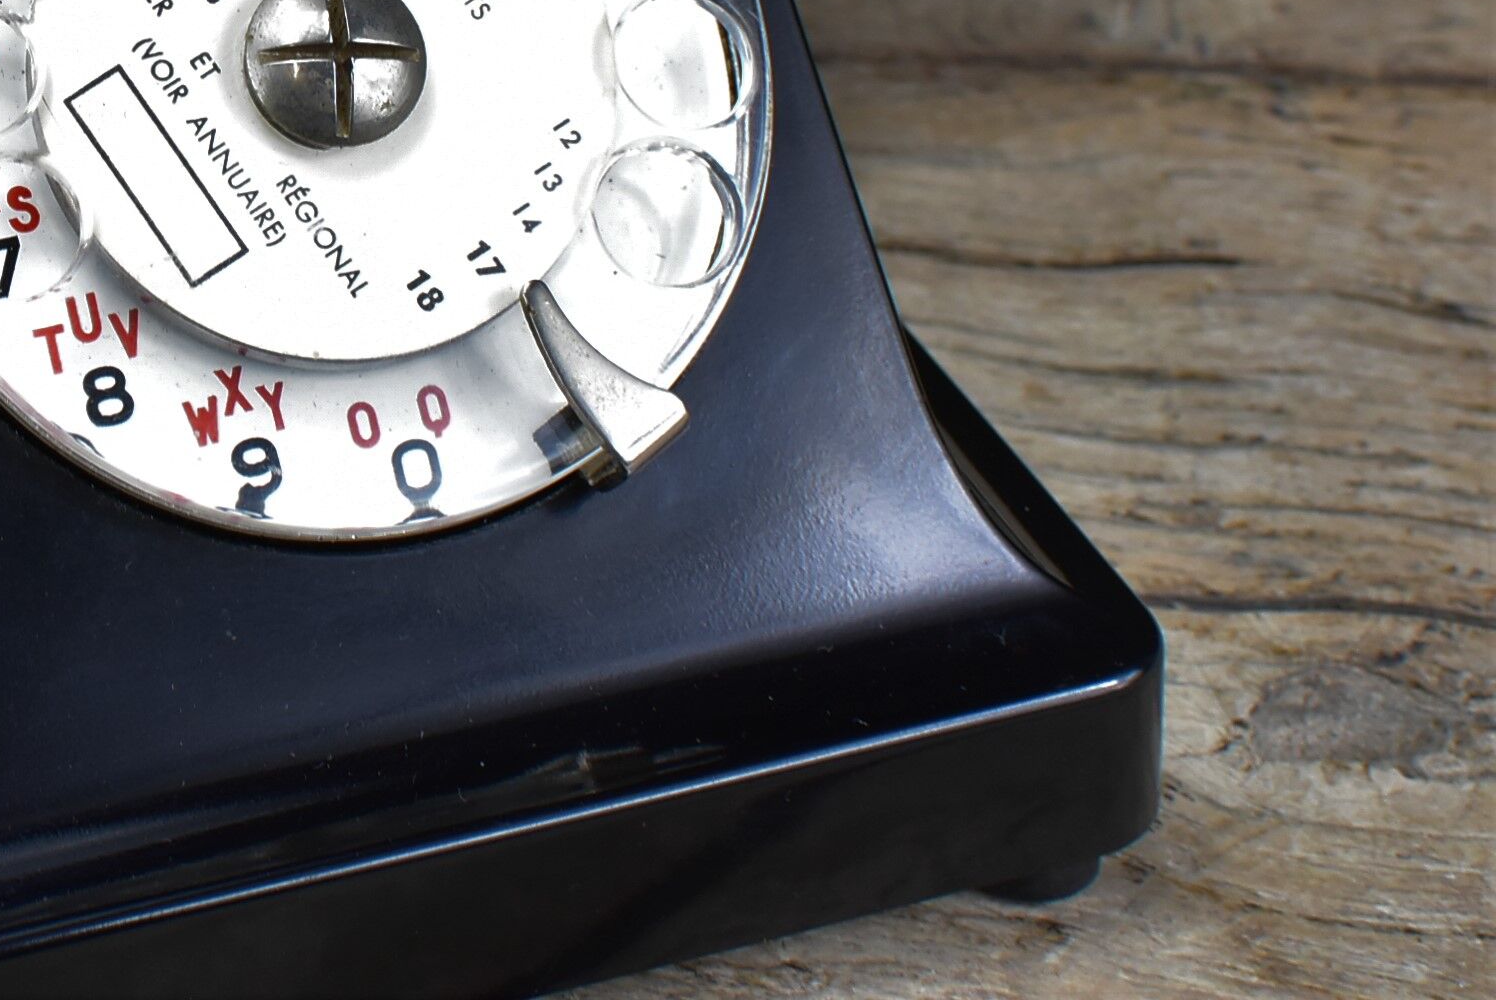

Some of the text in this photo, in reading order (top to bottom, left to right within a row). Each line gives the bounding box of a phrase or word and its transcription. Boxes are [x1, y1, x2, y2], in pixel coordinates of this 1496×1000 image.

[131, 38, 287, 247] (VOIR ANNUAIRE)
[552, 118, 582, 149] 12
[189, 52, 221, 80] ET
[276, 174, 369, 298] RÉGIONAL
[533, 162, 562, 192] 13
[512, 202, 542, 233] 14
[466, 240, 507, 277] 17
[406, 269, 445, 312] 18
[32, 291, 139, 375] TUV
[83, 366, 135, 427] 8
[182, 365, 284, 447] WXY
[231, 437, 283, 500] 9
